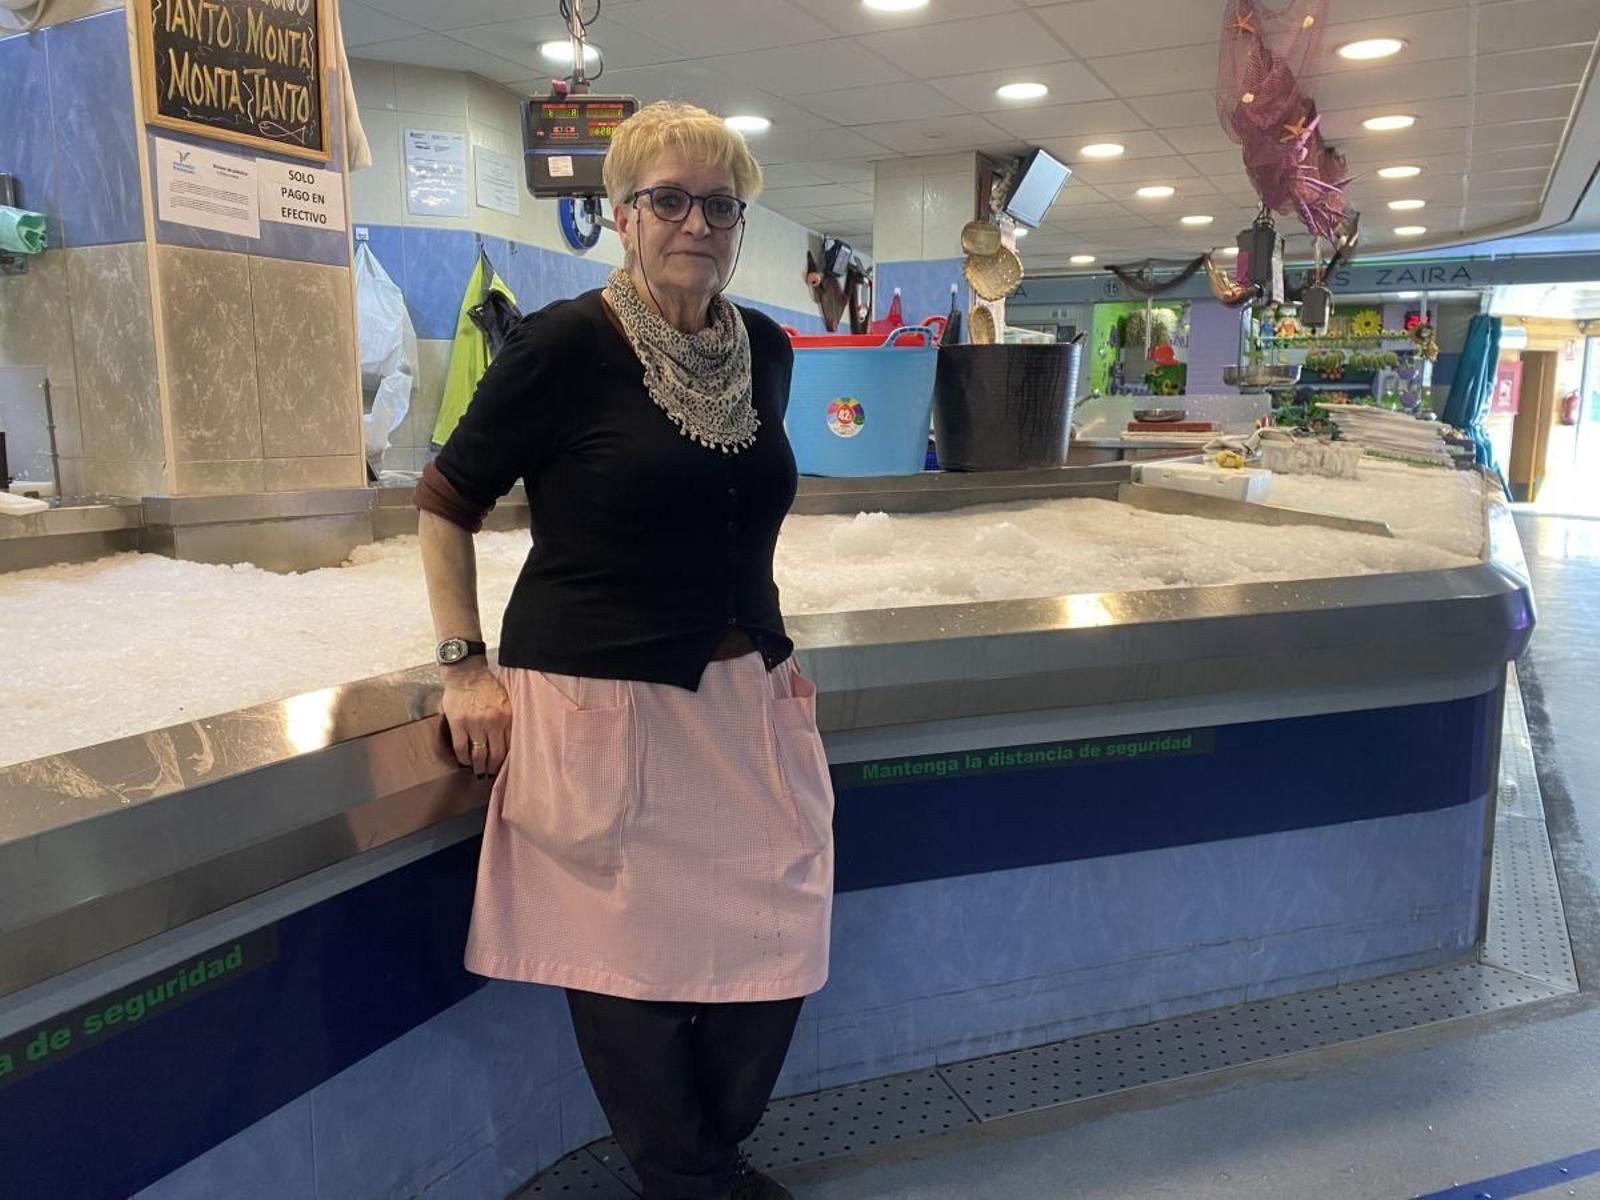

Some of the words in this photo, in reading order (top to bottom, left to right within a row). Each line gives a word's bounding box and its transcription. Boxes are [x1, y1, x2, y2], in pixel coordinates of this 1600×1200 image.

[165, 0, 232, 48] TANTO
[245, 6, 311, 69] MONTA
[167, 47, 245, 114] MONTA
[243, 67, 310, 123] TANTO
[288, 169, 315, 185] SOLO
[281, 187, 310, 202] PAGO
[312, 192, 325, 205] EN
[281, 206, 328, 225] EFECTIVO
[1375, 266, 1472, 286] ZAIRA
[1105, 282, 1120, 293] 15
[862, 760, 959, 779] Mantenga
[965, 754, 983, 769] la
[988, 746, 1074, 768] distancia
[1079, 743, 1100, 758] de
[1106, 735, 1193, 756] seguridad
[26, 1027, 71, 1061] de
[83, 945, 243, 1035] seguridad
